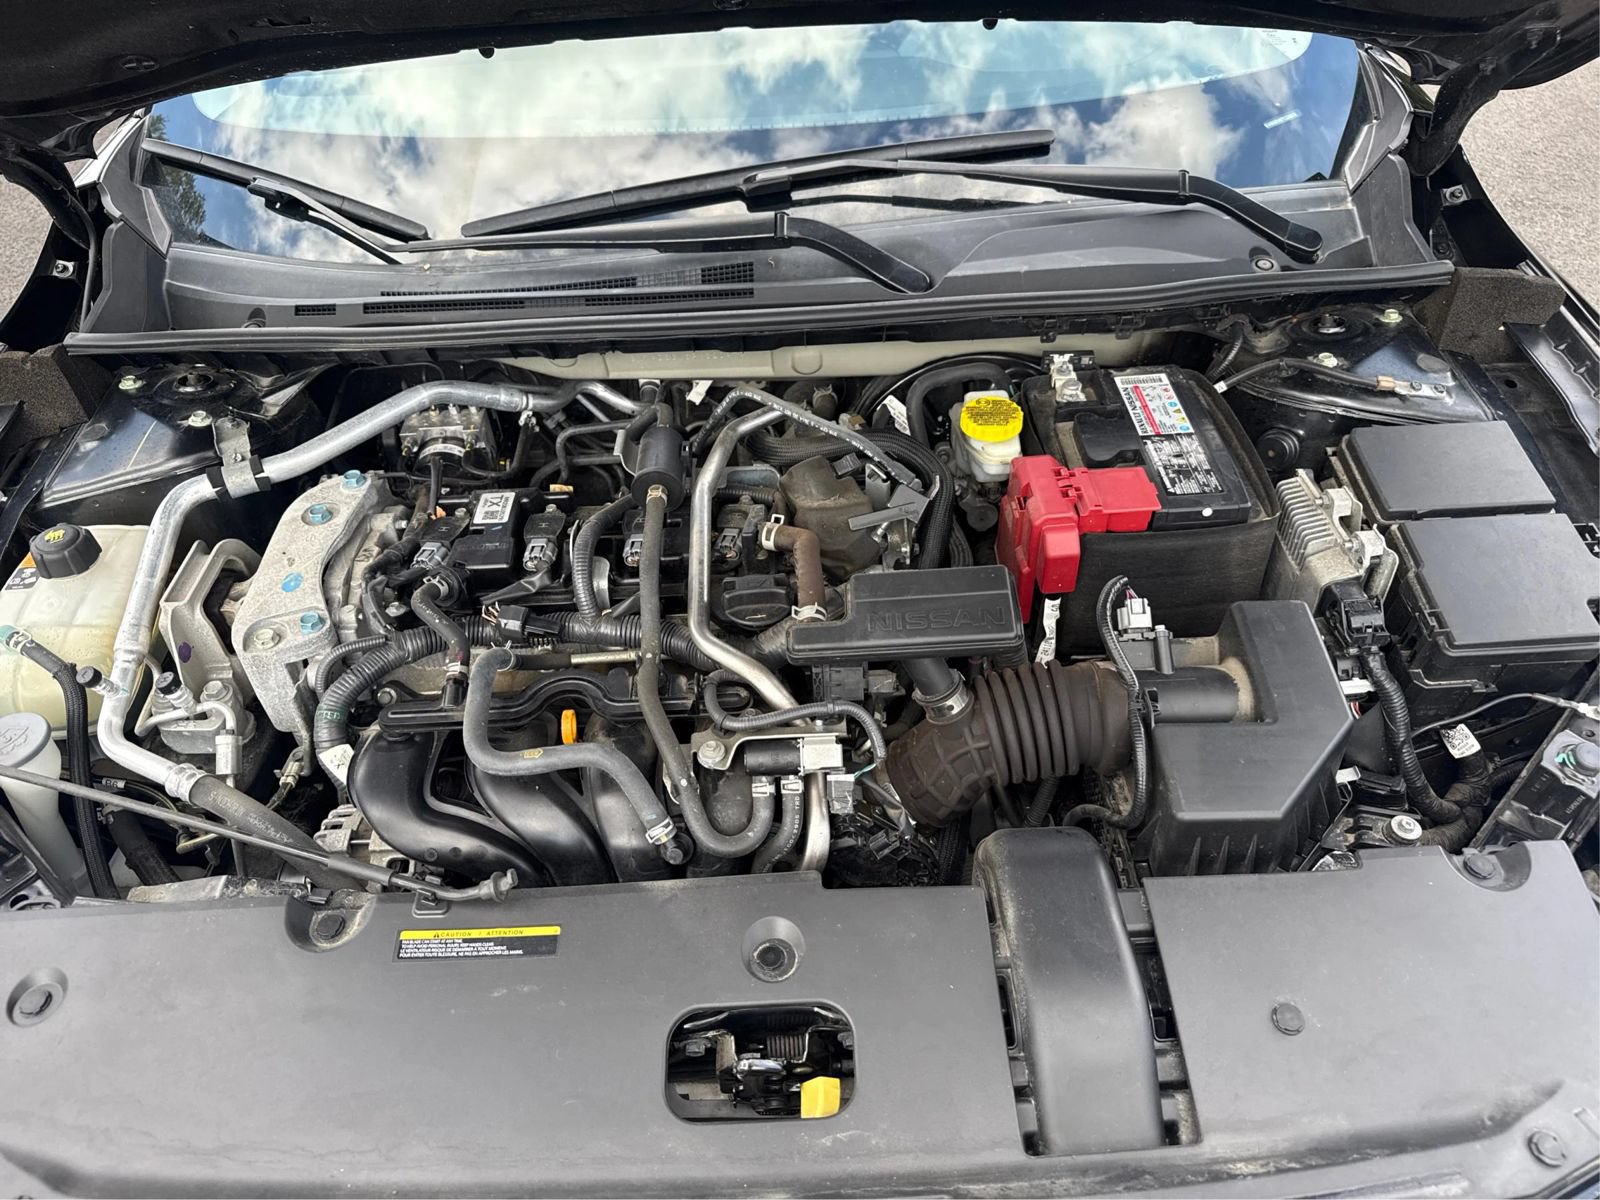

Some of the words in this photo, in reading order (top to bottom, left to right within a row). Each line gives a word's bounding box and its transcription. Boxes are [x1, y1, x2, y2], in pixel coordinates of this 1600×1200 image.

[1121, 386, 1138, 411] NISSAN
[1132, 411, 1149, 434] RENAULT
[488, 494, 504, 508] TX
[866, 606, 1006, 632] NISSAN
